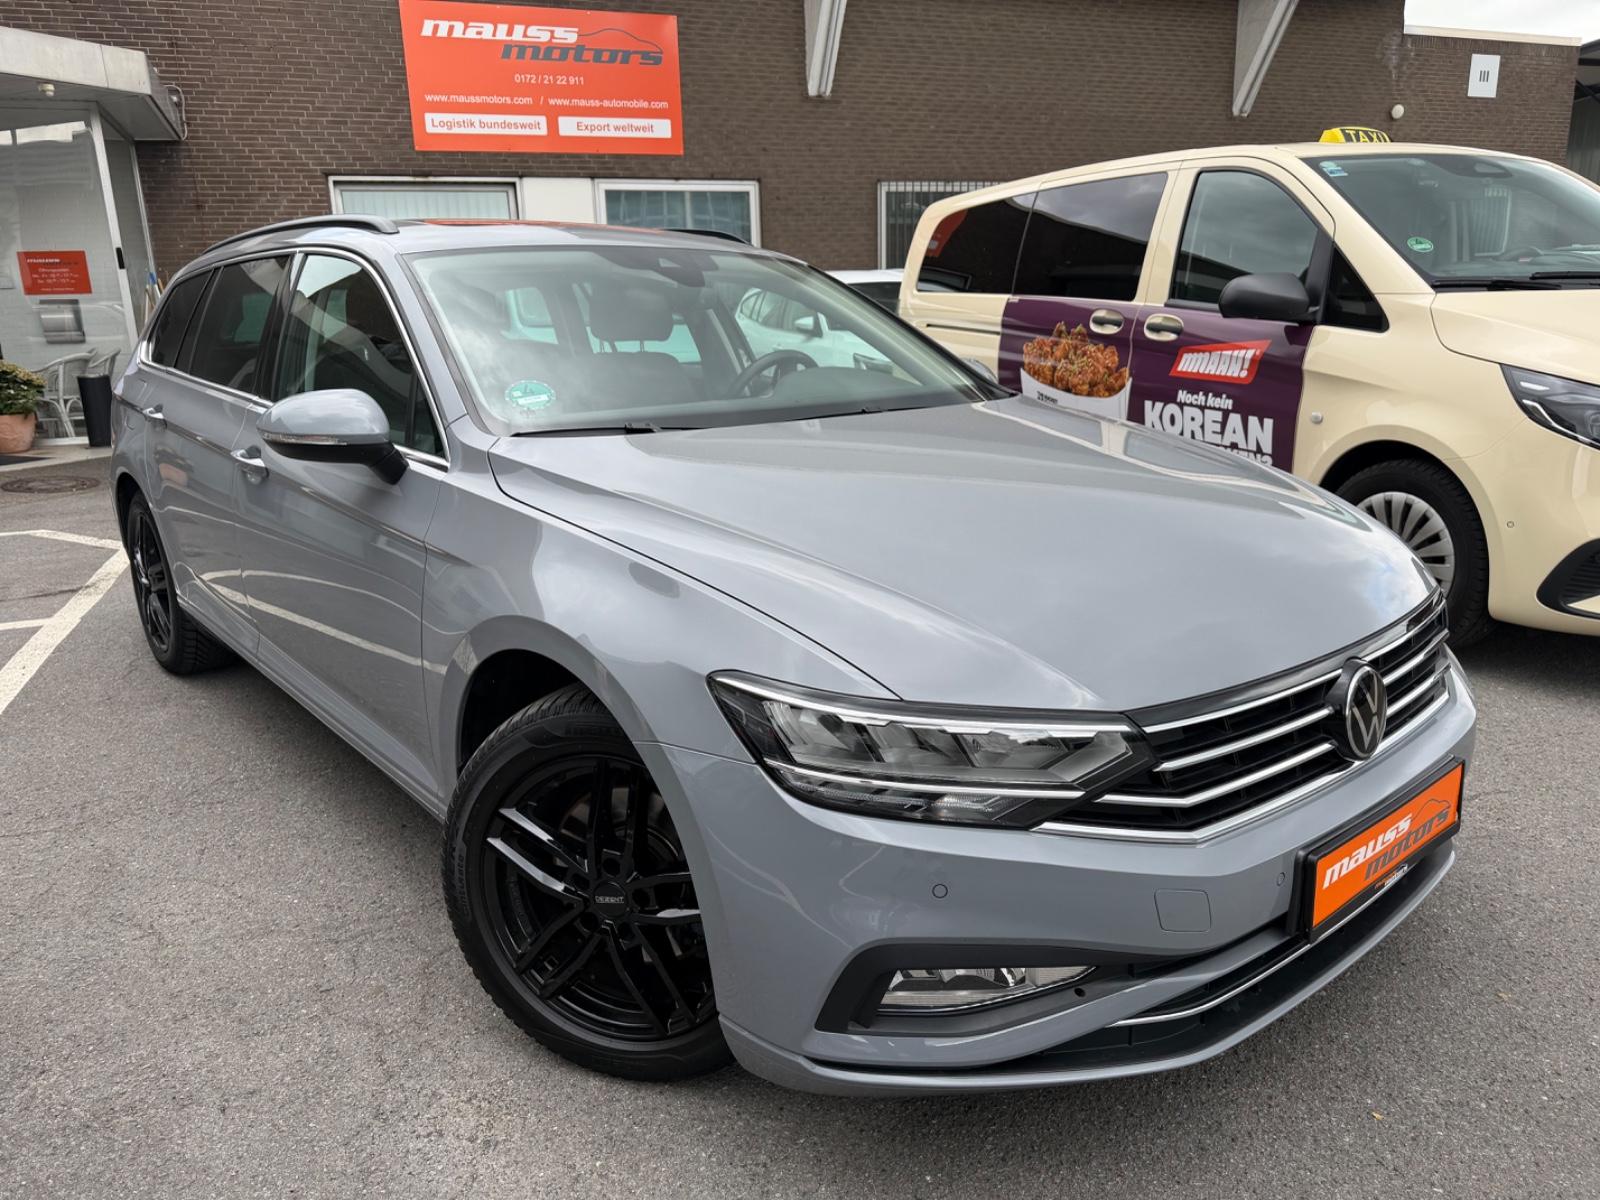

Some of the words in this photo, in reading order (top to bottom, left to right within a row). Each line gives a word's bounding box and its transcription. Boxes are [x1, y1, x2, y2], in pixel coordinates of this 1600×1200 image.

[420, 19, 579, 44] mauss
[501, 44, 663, 66] motors
[514, 74, 536, 84] 0172
[543, 75, 554, 85] 21
[556, 76, 568, 85] 22
[569, 76, 585, 86] 911
[424, 93, 533, 106] www.maussmotors.com
[548, 96, 669, 109] www.mauss-automobile.com
[430, 118, 476, 132] Logistik
[479, 119, 541, 131] bundesweit
[576, 121, 612, 134] Export
[613, 122, 654, 134] weltweit
[1176, 390, 1206, 405] Noch
[1206, 392, 1233, 410] kein
[1144, 400, 1273, 455] KOREAN
[1322, 813, 1412, 890] mauss
[1364, 808, 1449, 881] motors
